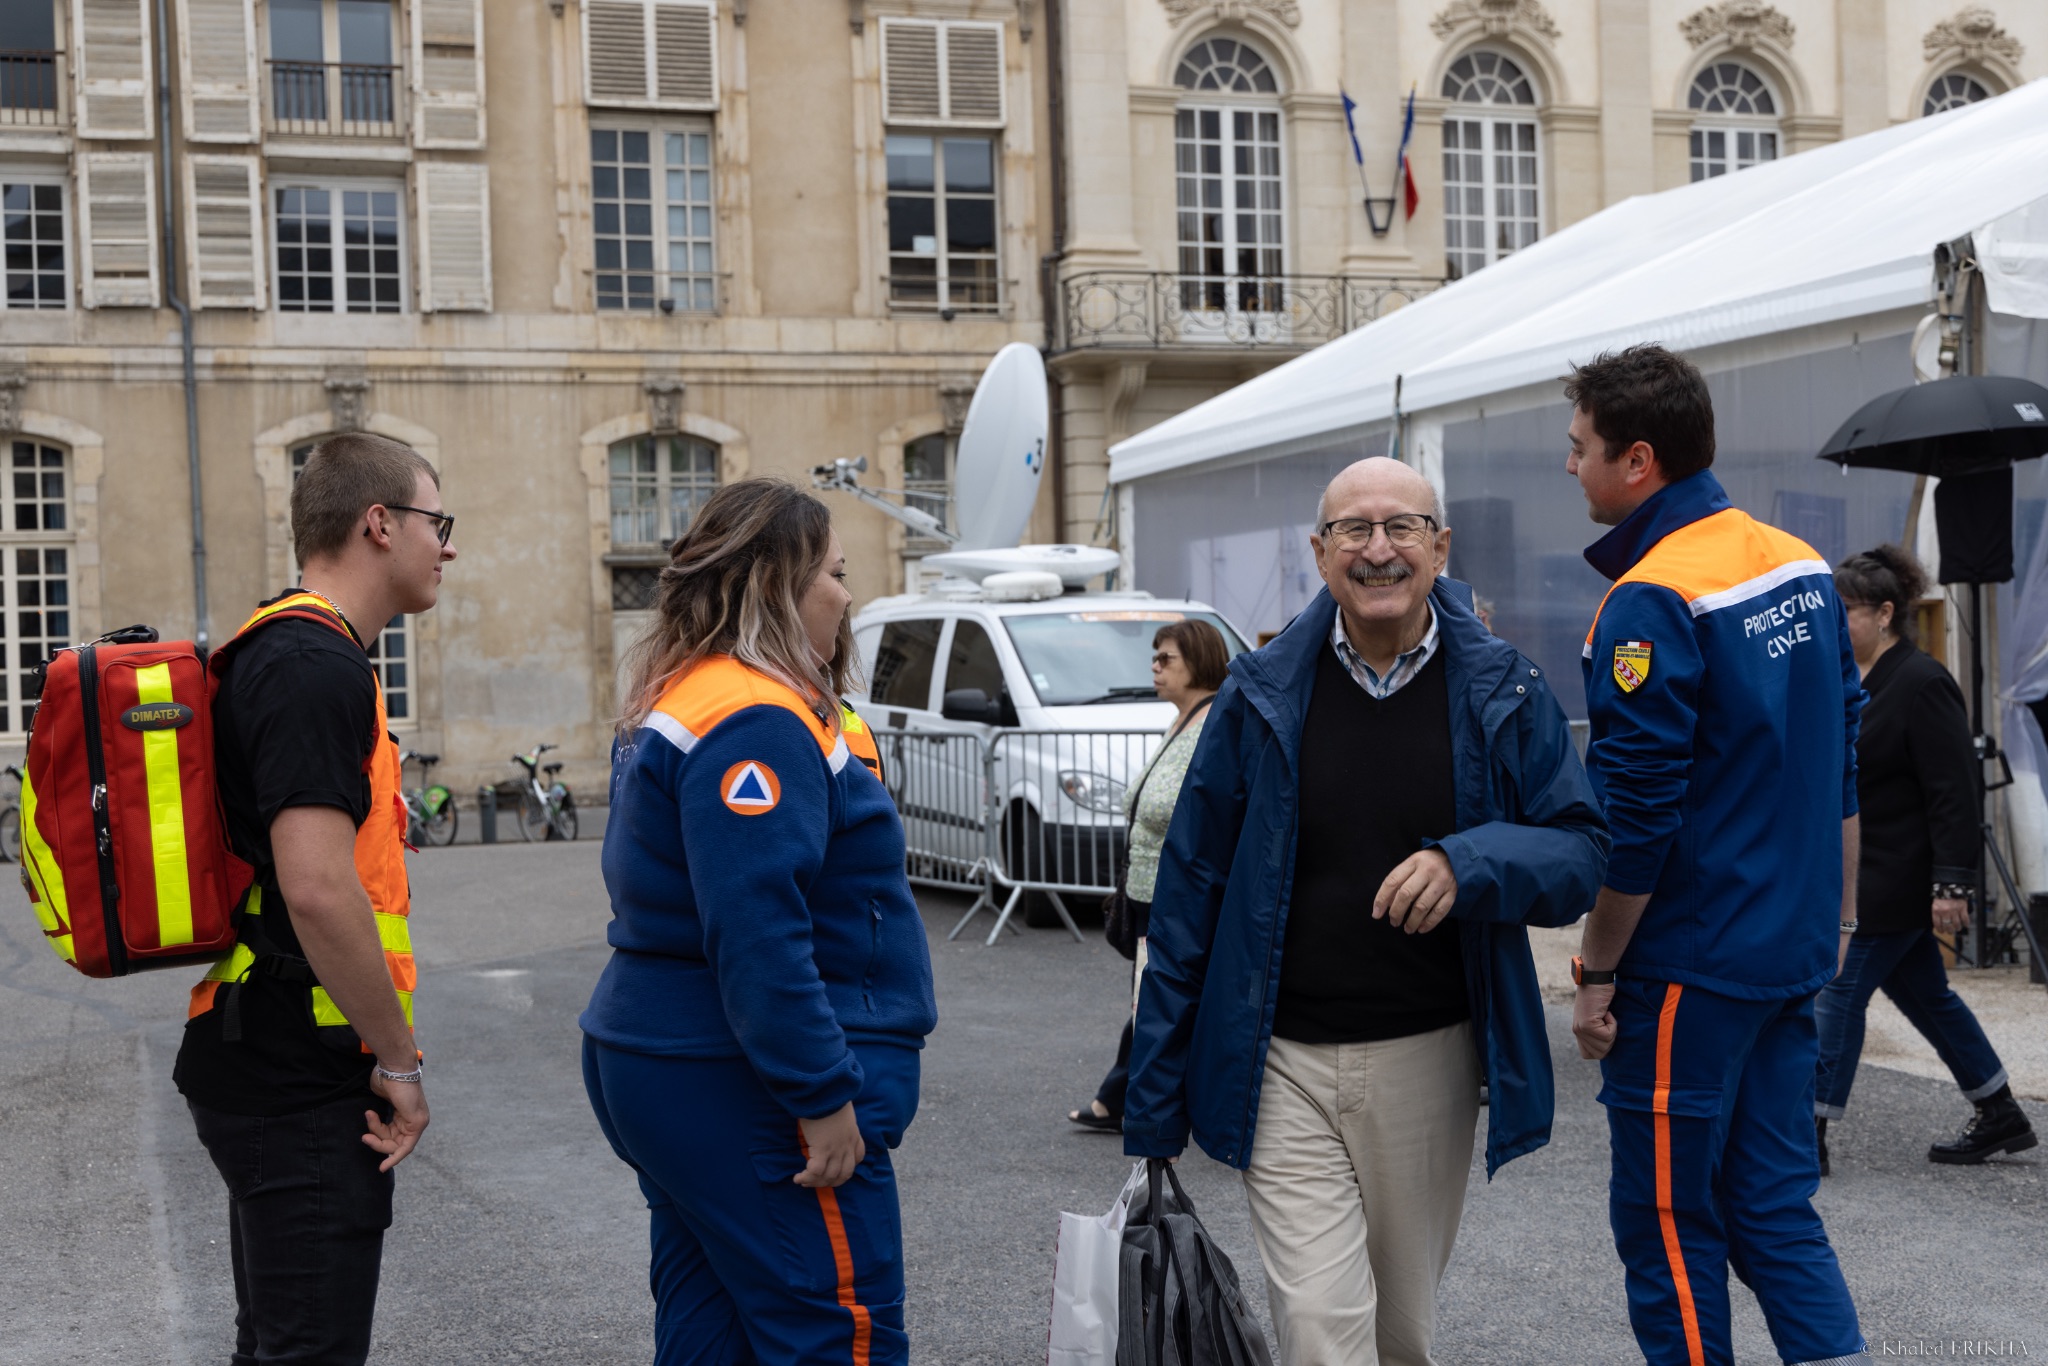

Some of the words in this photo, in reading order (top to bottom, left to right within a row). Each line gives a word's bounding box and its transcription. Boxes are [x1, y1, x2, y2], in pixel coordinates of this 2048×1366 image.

[1743, 589, 1826, 638] PROTECTION
[1767, 621, 1812, 659] CIVLE
[131, 708, 181, 722] DIMATEX
